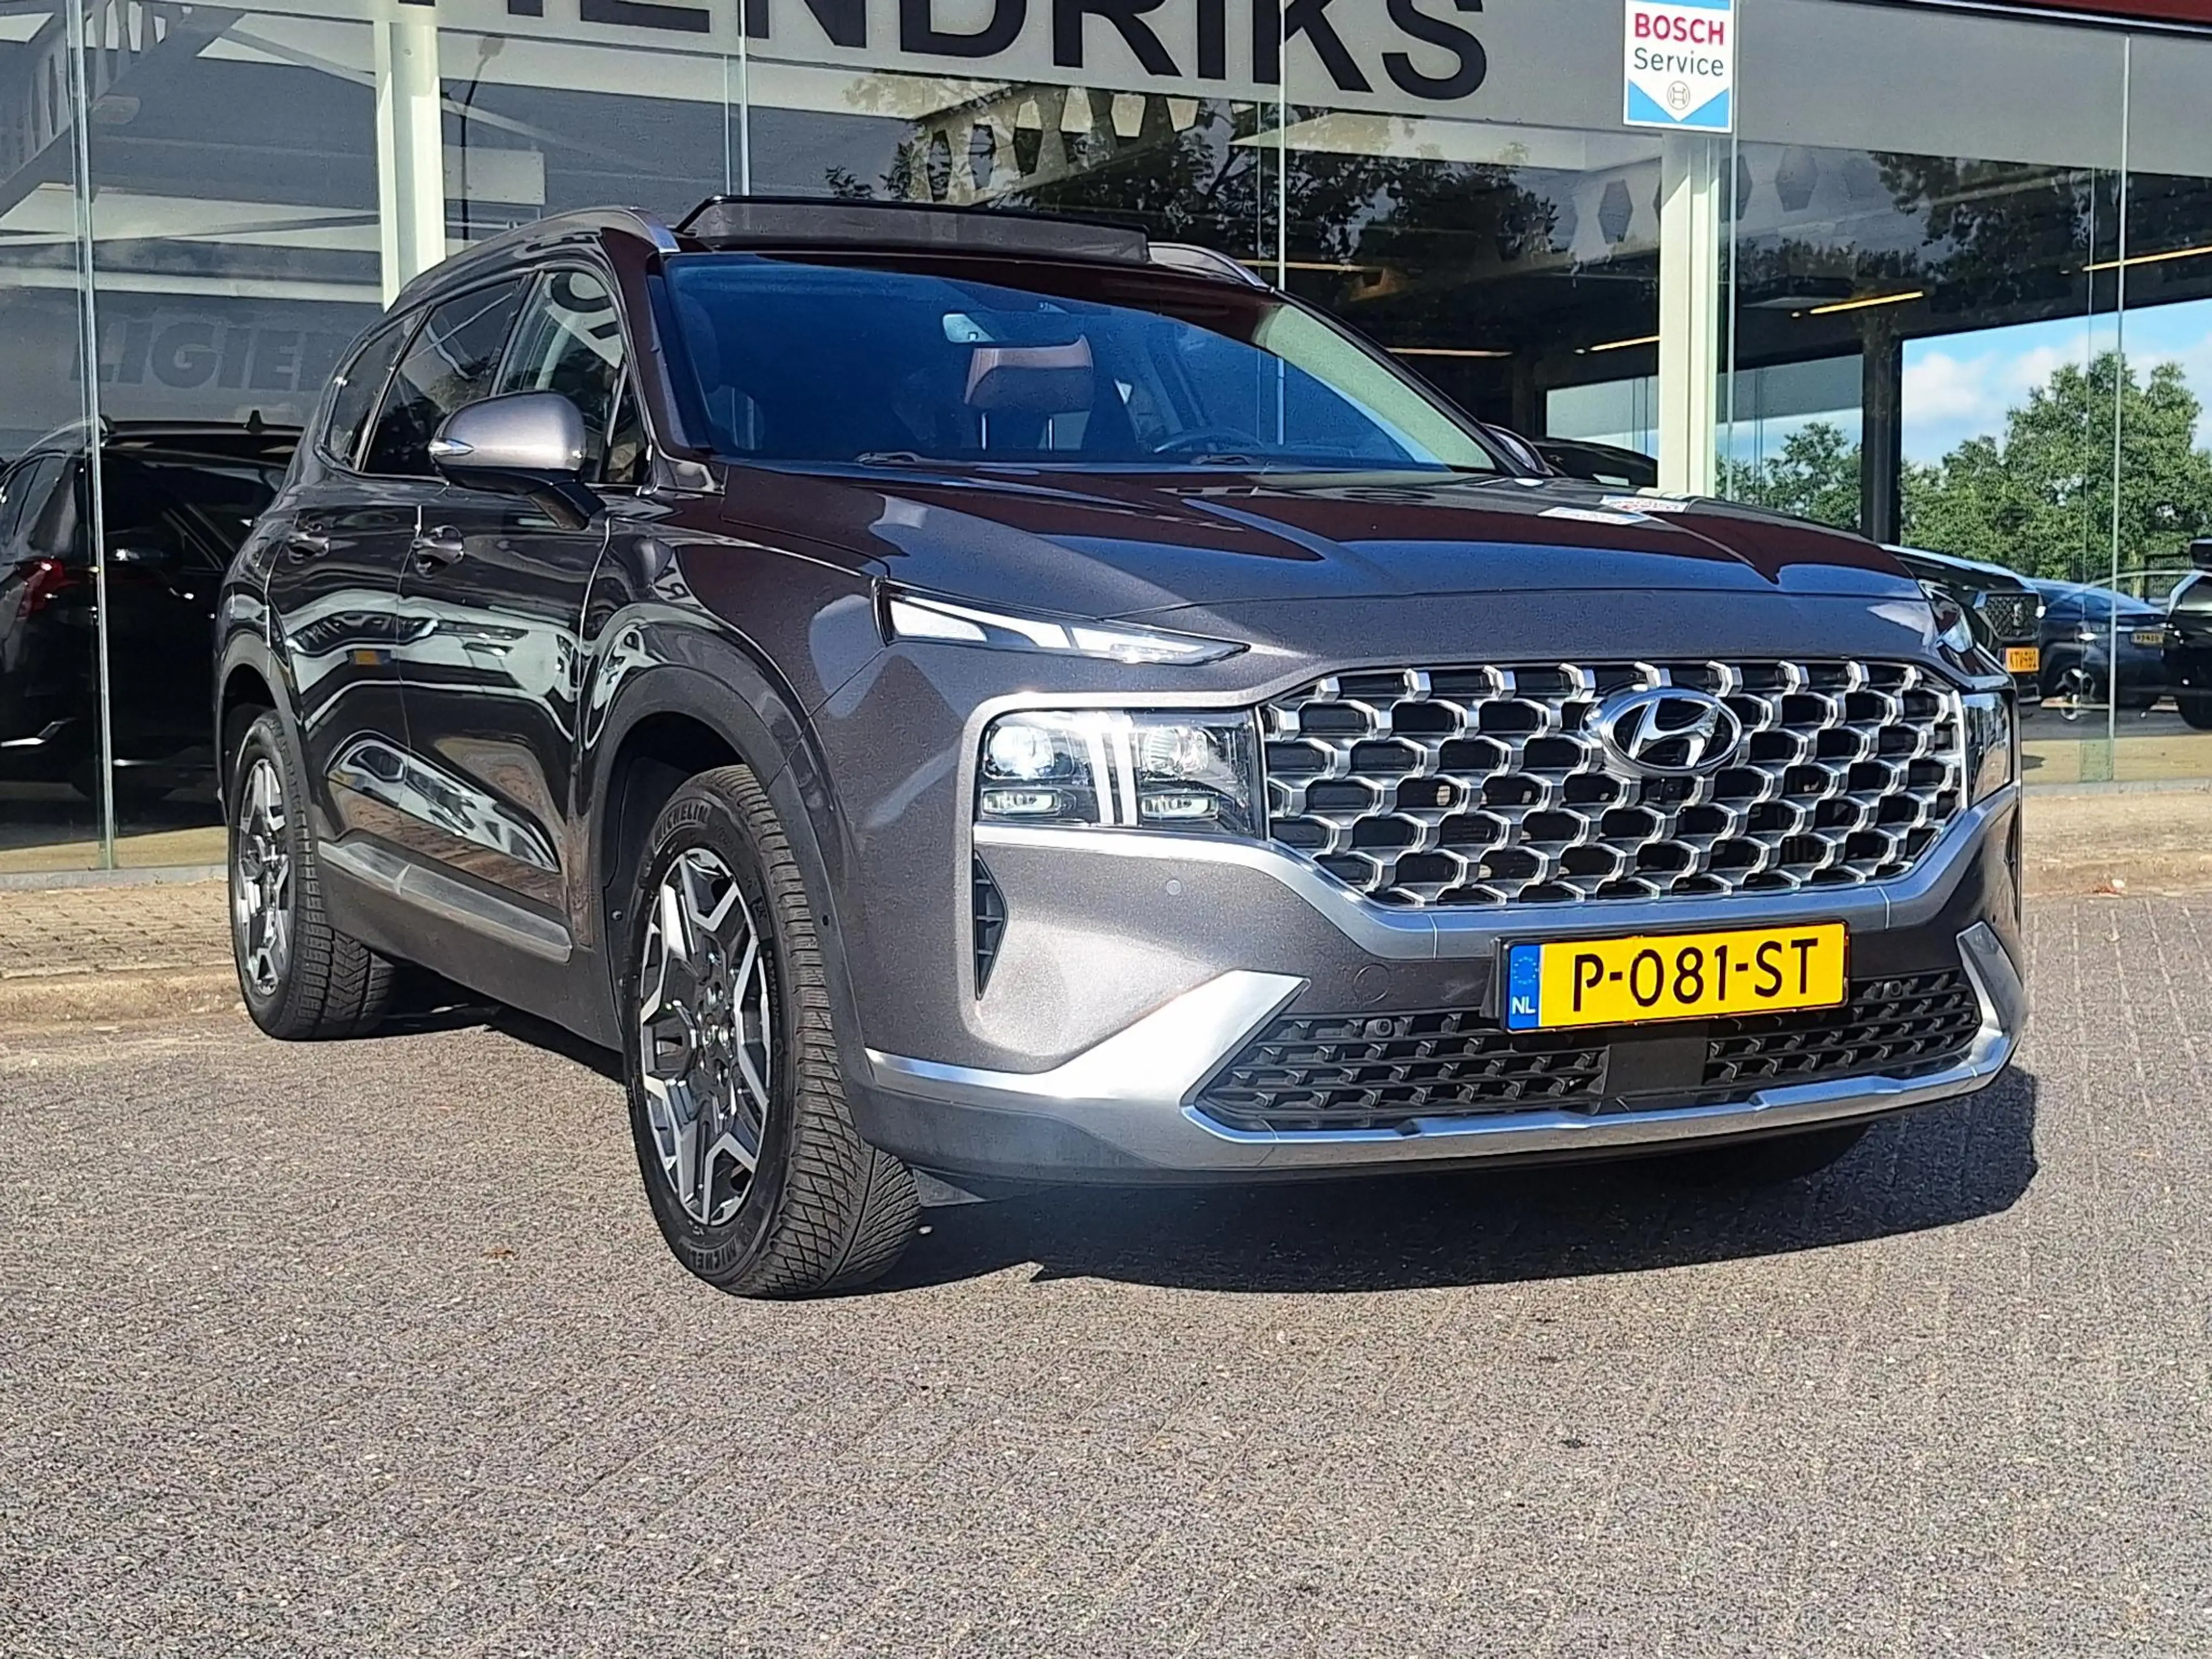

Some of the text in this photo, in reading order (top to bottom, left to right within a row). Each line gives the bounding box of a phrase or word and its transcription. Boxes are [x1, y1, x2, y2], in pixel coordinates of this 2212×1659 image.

[1634, 13, 1724, 46] BOSCH
[1634, 47, 1724, 77] Service
[1573, 937, 1819, 1012] P-081-ST
[1512, 996, 1536, 1014] NL
